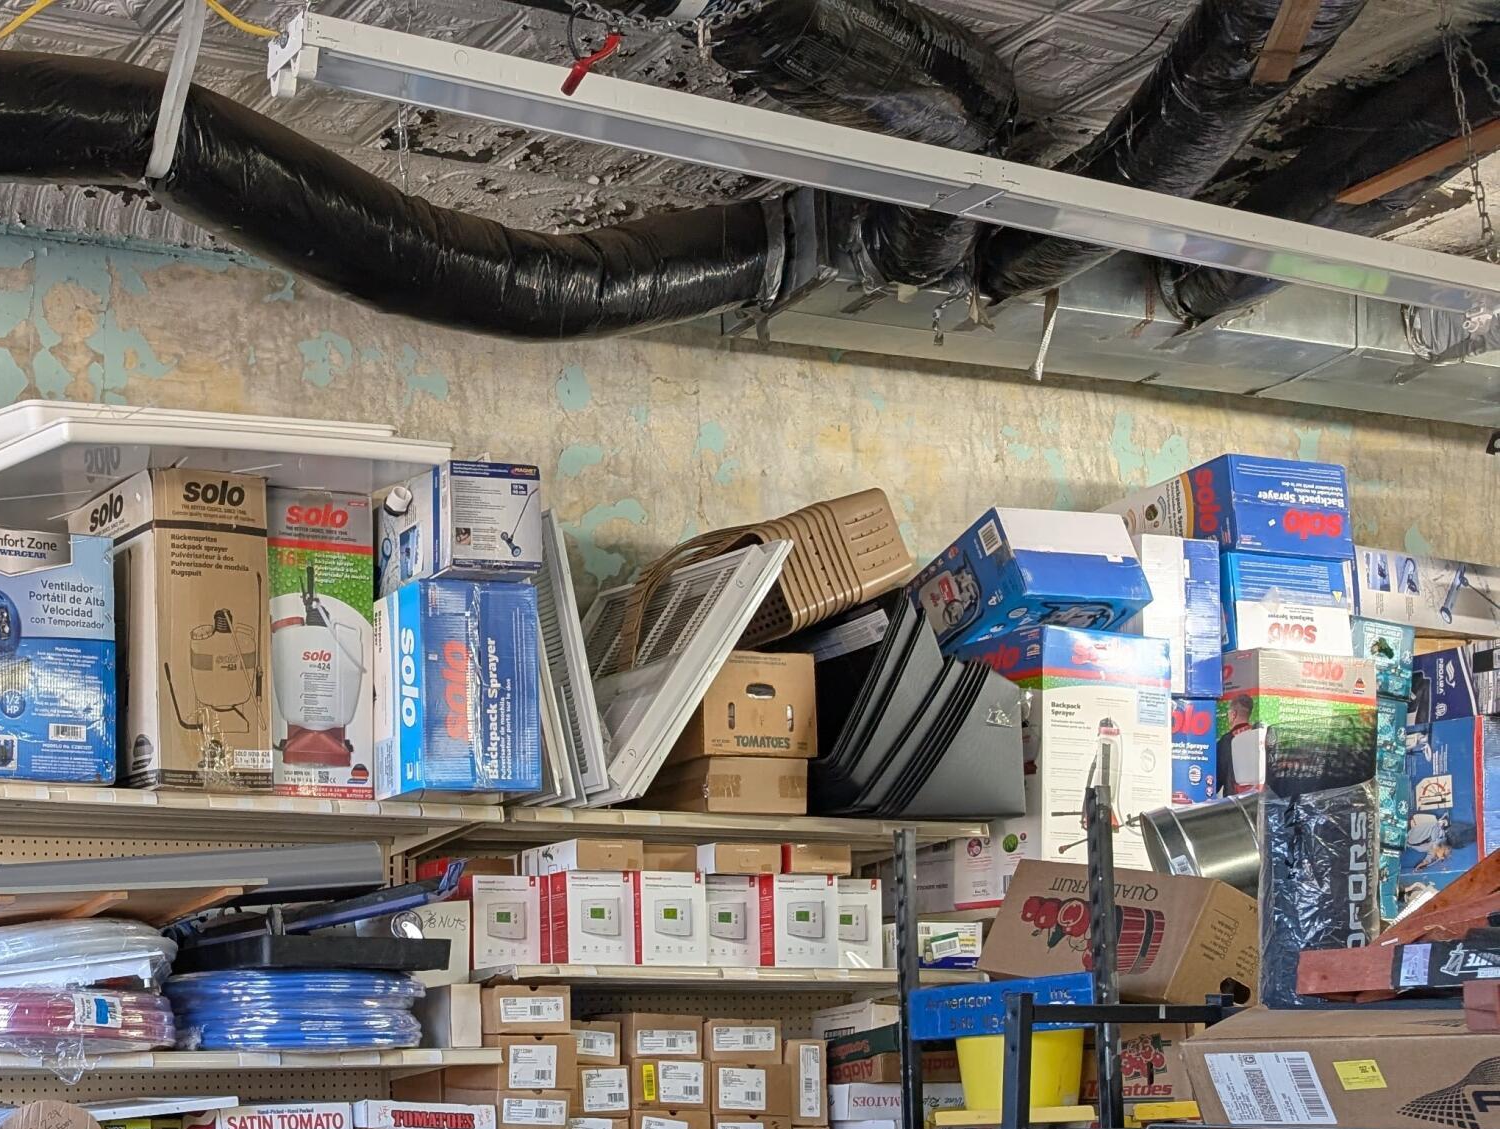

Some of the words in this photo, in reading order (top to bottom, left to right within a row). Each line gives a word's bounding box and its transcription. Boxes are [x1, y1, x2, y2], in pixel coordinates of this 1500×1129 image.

[182, 479, 245, 506] solo
[1257, 489, 1297, 504] Sprayer
[1195, 469, 1222, 533] solo
[1299, 493, 1345, 508] Backpack
[89, 492, 124, 533] solo
[286, 504, 349, 529] solo
[1283, 508, 1345, 540] solo
[27, 535, 58, 551] Zone
[170, 543, 202, 552] Backpack
[203, 545, 229, 554] sprayer
[224, 554, 235, 562] dos
[215, 562, 223, 570] de
[40, 579, 95, 594] Ventilador
[28, 590, 67, 604] Portátil
[69, 593, 82, 605] de
[84, 595, 106, 608] Alta
[41, 603, 93, 619] Velocidad
[30, 616, 46, 625] con
[47, 616, 105, 631] Temporizador
[1267, 622, 1318, 645] solo
[302, 650, 332, 662] solo
[317, 663, 331, 672] 424
[487, 637, 502, 698] Sprayer
[401, 627, 420, 728] solo
[5, 692, 20, 705] 1/2
[1050, 701, 1082, 711] Backpack
[6, 705, 20, 715] HP
[1050, 708, 1076, 718] Sprayer
[487, 703, 502, 780] Backpack
[734, 735, 790, 750] TOMATOES
[1048, 877, 1089, 894] FRUIT
